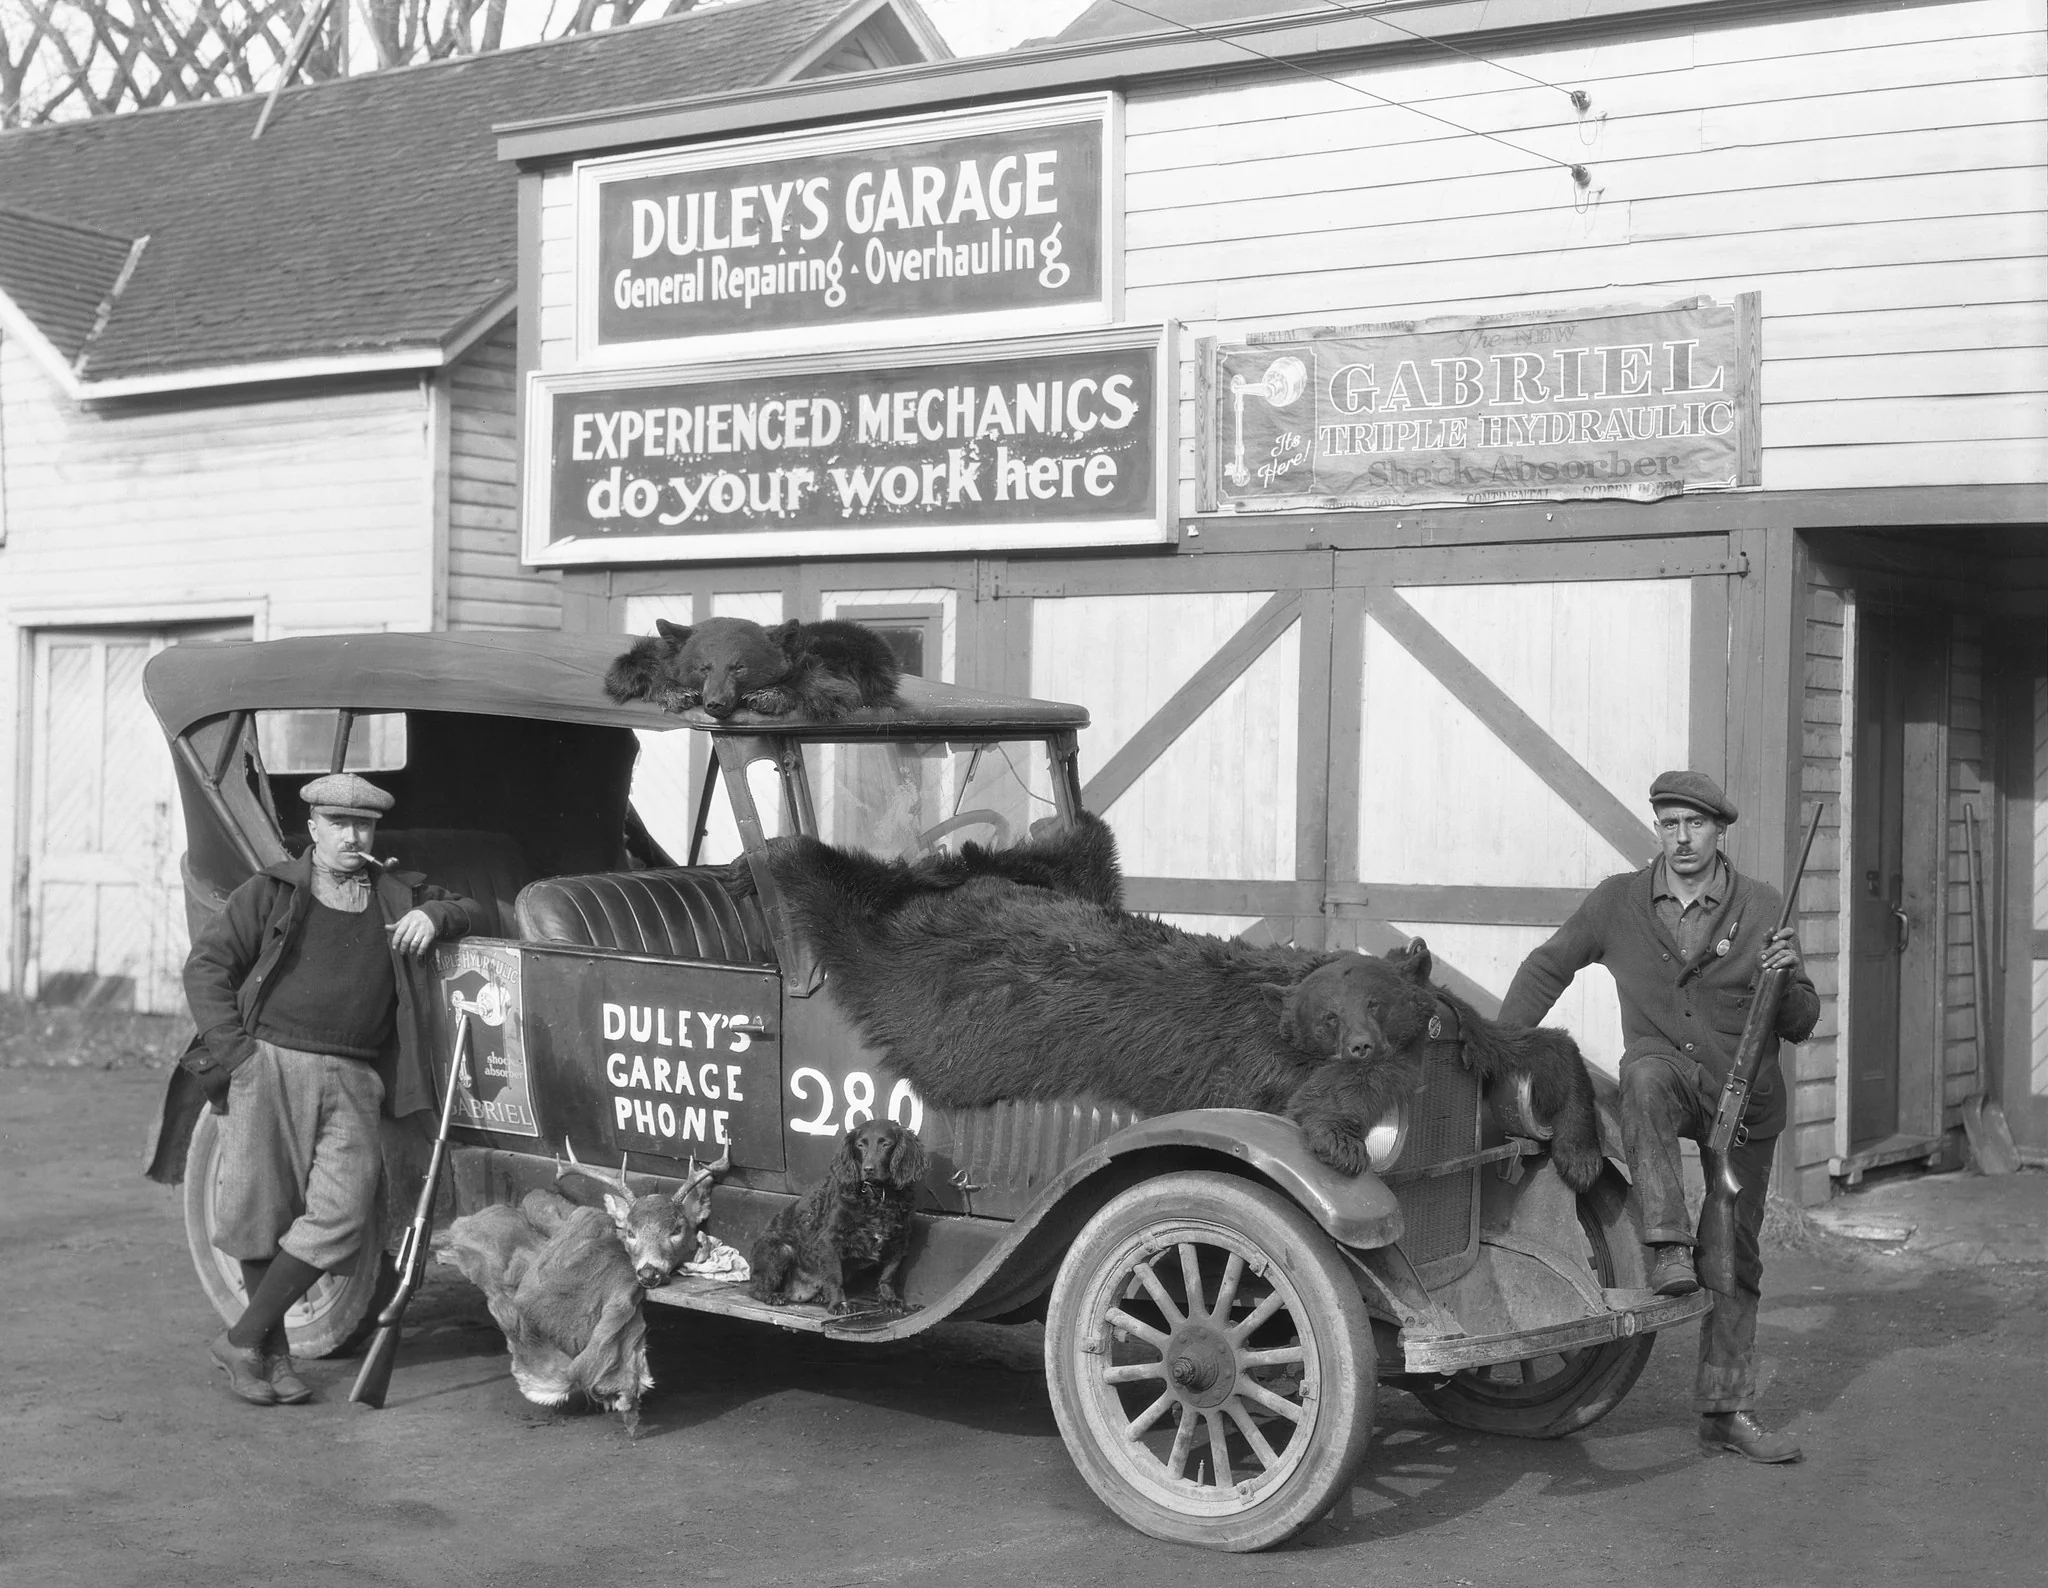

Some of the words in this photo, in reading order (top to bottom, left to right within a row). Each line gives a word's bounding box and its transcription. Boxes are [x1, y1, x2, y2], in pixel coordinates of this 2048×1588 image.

[631, 177, 830, 259] DULEY'S
[845, 149, 1058, 234] GARAGE
[614, 259, 704, 310] General
[711, 240, 847, 308] Repairing
[865, 221, 1070, 289] Overhauling
[1453, 328, 1501, 356] The
[1513, 325, 1578, 347] NEW
[1327, 338, 1725, 415] GABRIEL
[572, 397, 842, 461] EXPERIENCED
[858, 373, 1134, 443] MECHANICS
[1319, 417, 1466, 457] TRIPLE
[1477, 400, 1734, 448] HYDRAULIC
[1257, 439, 1312, 488] Here!
[1270, 431, 1301, 457] Its
[1367, 456, 1478, 488] Shock
[1490, 450, 1680, 482] Absorber
[586, 465, 659, 520] do
[657, 467, 817, 526] your
[831, 448, 982, 508] work
[996, 446, 1118, 501] here
[602, 1002, 751, 1053] DULEY'S
[606, 1053, 744, 1101] GARAGE
[614, 1096, 732, 1146] PHONE
